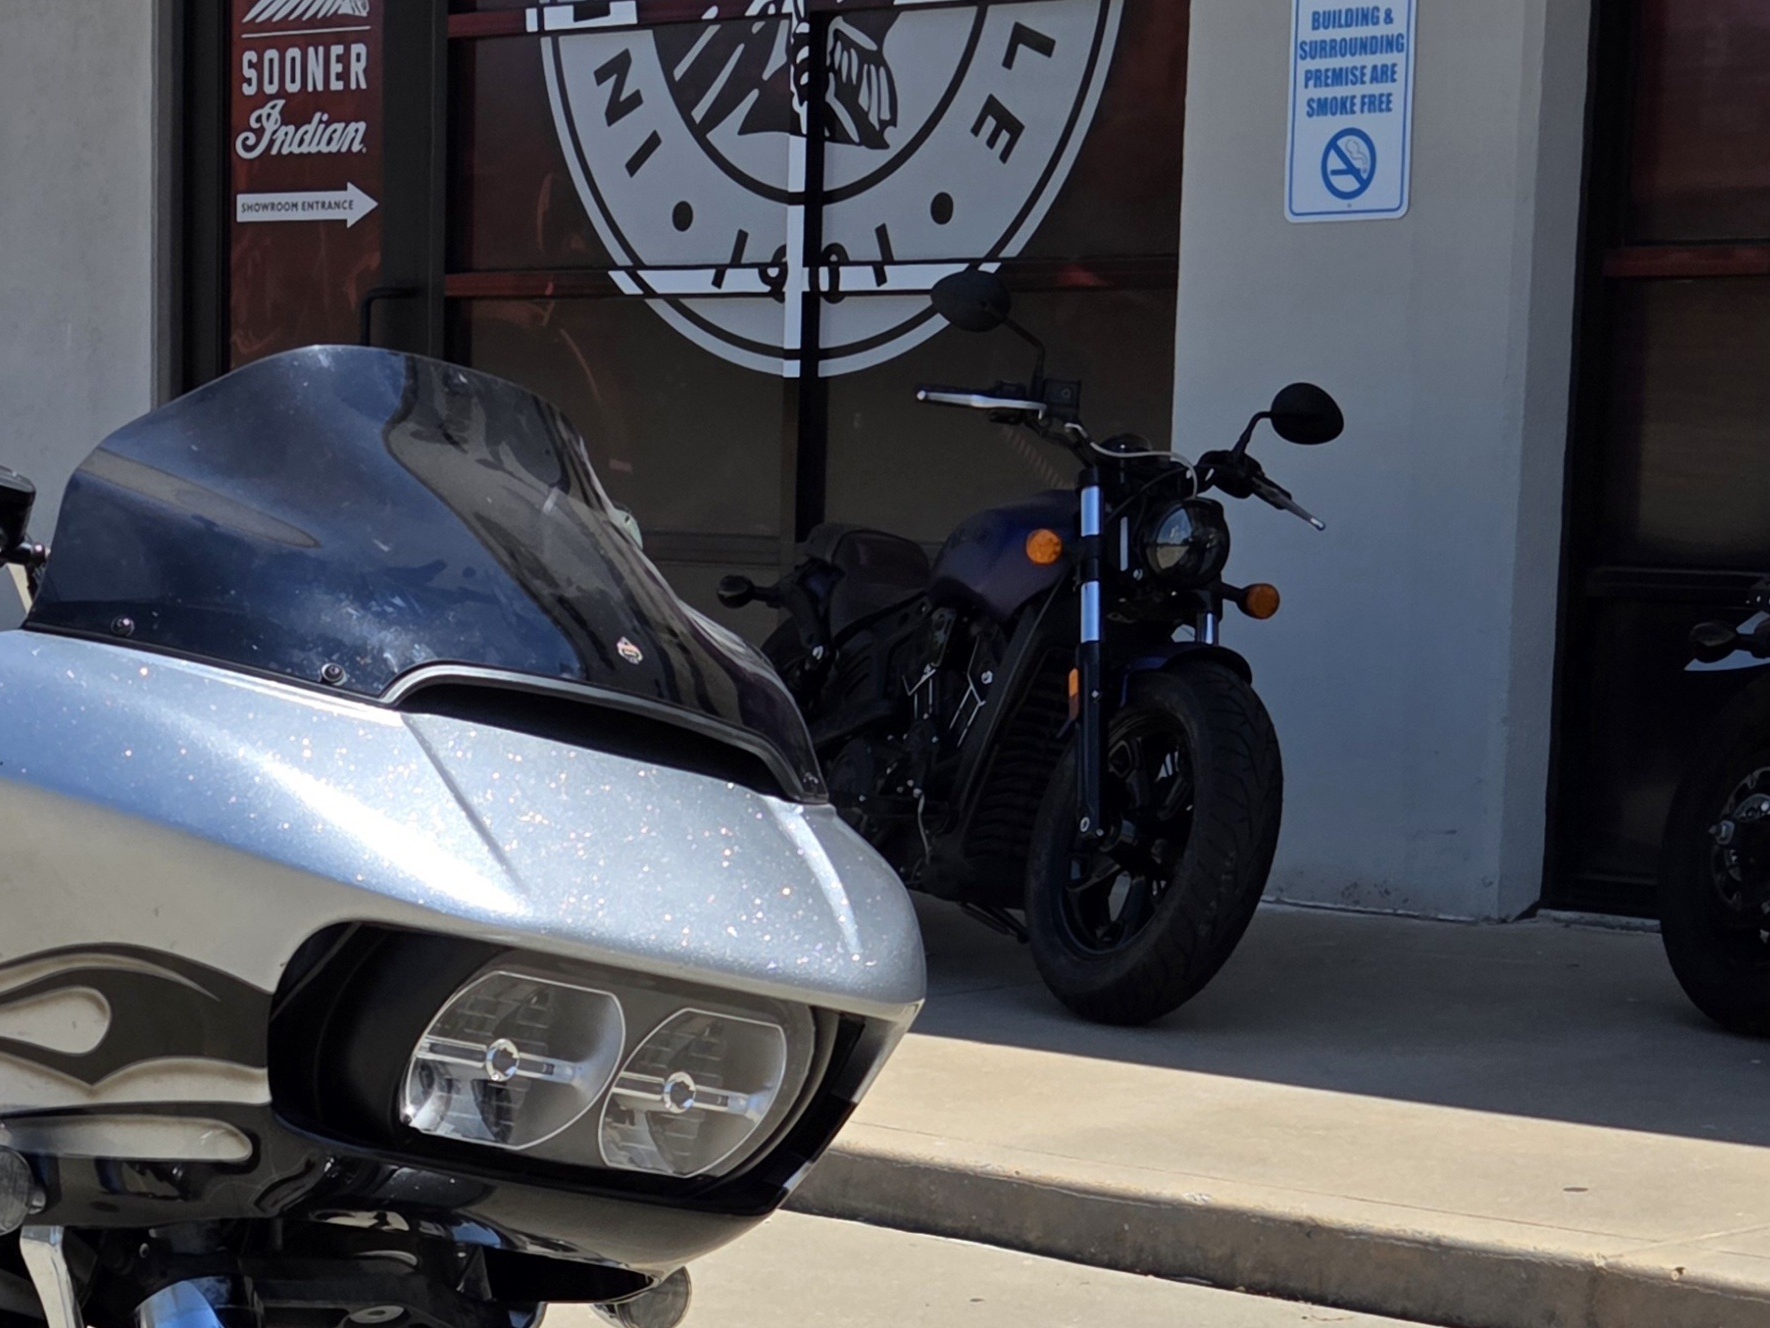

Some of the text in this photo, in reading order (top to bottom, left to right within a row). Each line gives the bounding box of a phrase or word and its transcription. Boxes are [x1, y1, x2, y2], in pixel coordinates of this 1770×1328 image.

[1311, 6, 1394, 31] BUILDING &
[1299, 33, 1405, 61] SURROUNDING
[242, 43, 367, 96] SOONER
[1304, 63, 1398, 89] PREMISE ARE
[1306, 93, 1393, 118] SMOKE FREE
[235, 99, 366, 160] Indian
[241, 199, 354, 213] SHOWROOM ENTRANCE
